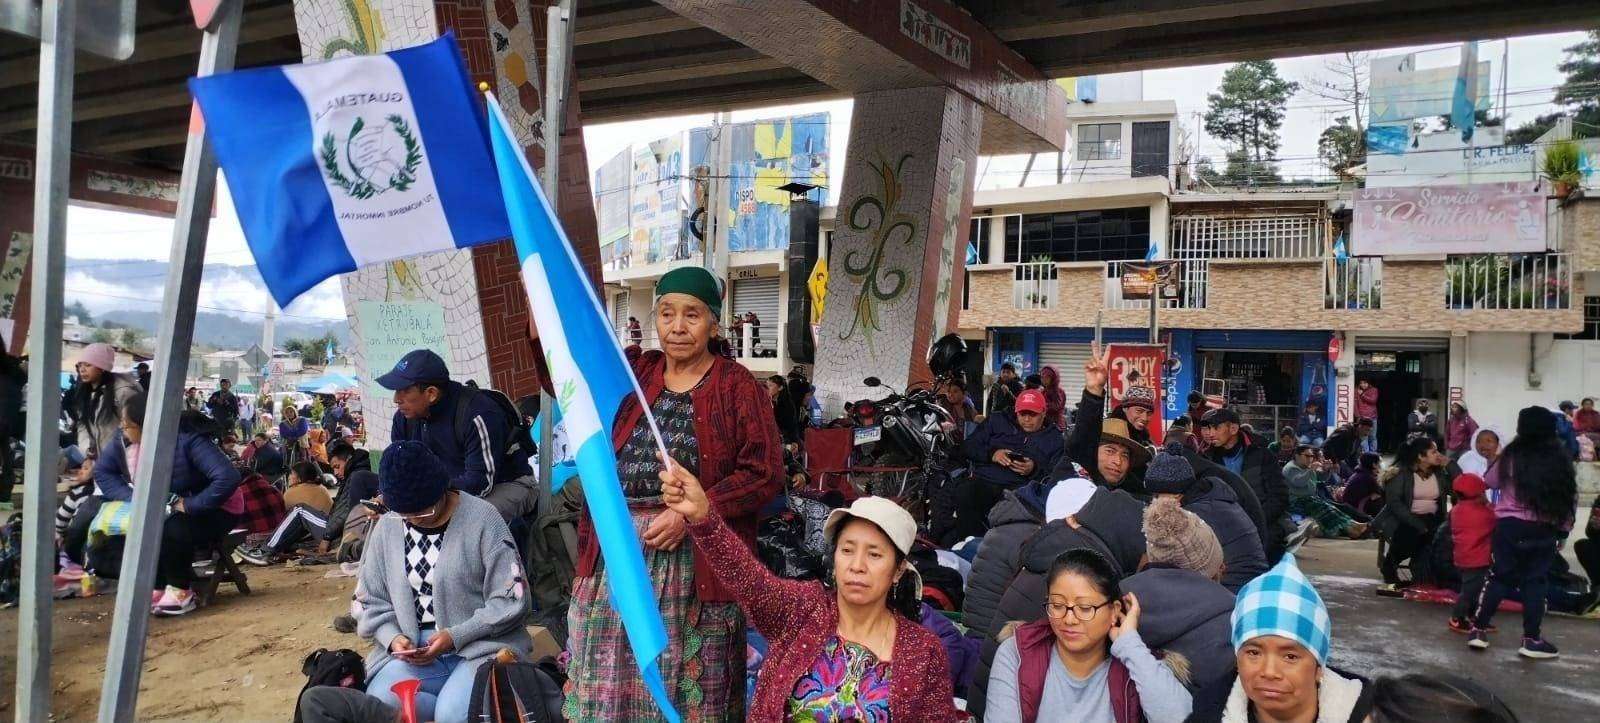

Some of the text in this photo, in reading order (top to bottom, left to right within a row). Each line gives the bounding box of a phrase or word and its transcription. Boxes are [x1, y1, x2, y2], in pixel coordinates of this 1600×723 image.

[1418, 187, 1480, 209] Servicio
[1111, 356, 1157, 401] 3 HOY
[1167, 375, 1179, 411] pepsi
